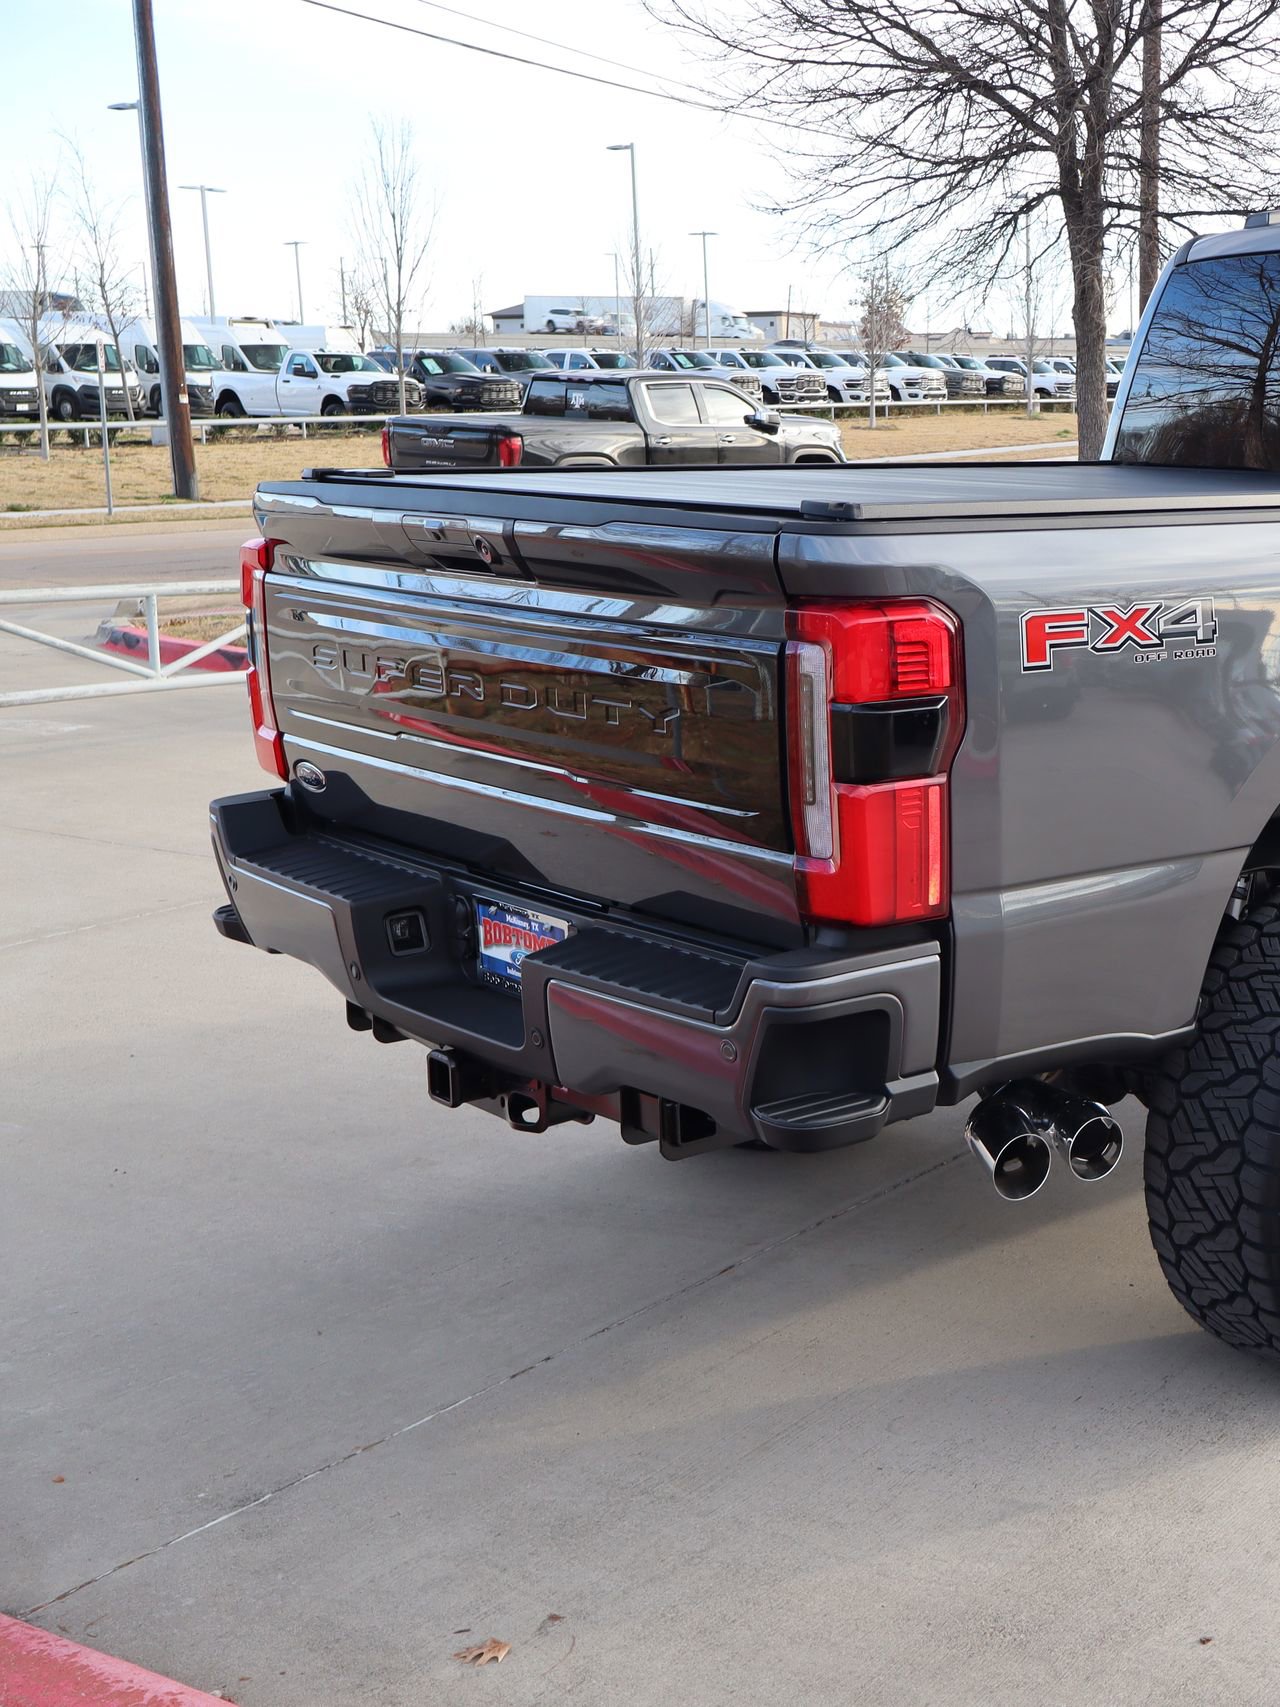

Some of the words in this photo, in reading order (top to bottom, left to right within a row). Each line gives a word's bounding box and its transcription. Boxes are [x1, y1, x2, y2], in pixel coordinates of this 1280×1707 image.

[1018, 596, 1219, 675] FX4
[1134, 652, 1168, 665] OFF
[1173, 647, 1217, 661] ROAD
[313, 644, 485, 700] SUPER
[500, 680, 681, 734] DUTY
[530, 921, 540, 932] TX
